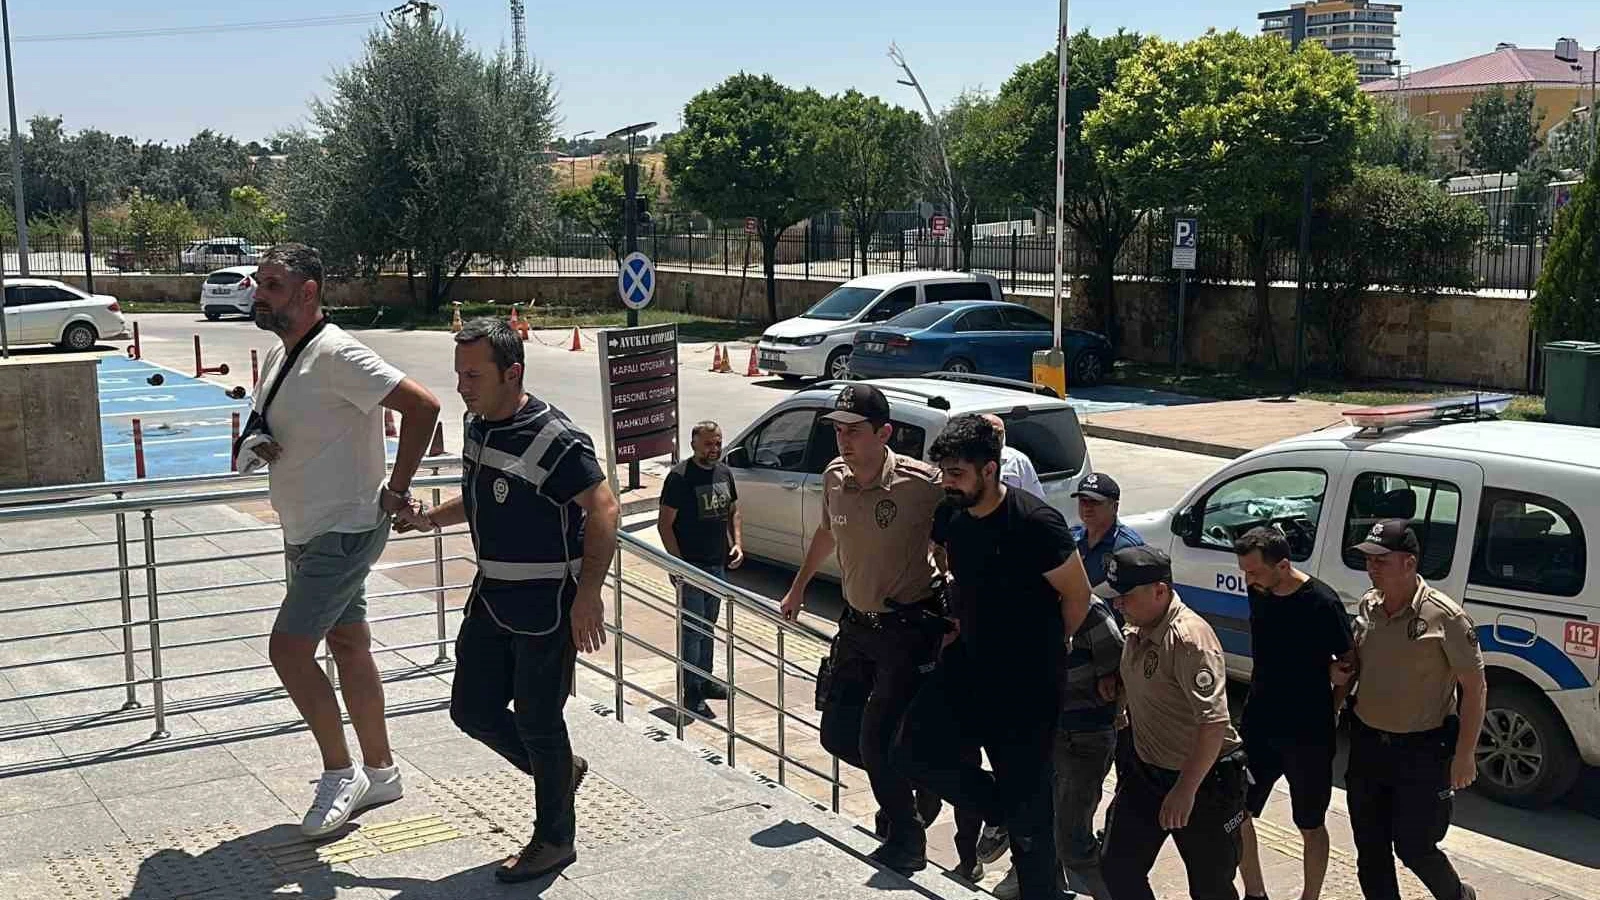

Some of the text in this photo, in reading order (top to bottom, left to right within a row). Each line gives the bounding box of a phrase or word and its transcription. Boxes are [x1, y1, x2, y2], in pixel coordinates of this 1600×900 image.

[1176, 221, 1191, 246] P
[620, 334, 650, 348] AVUKAT
[612, 363, 639, 376] KAPALI
[614, 391, 648, 404] PERSONEL
[616, 416, 649, 431] MAHKUM
[701, 493, 727, 510] Lee
[1216, 572, 1246, 593] POL
[1569, 625, 1594, 645] 112
